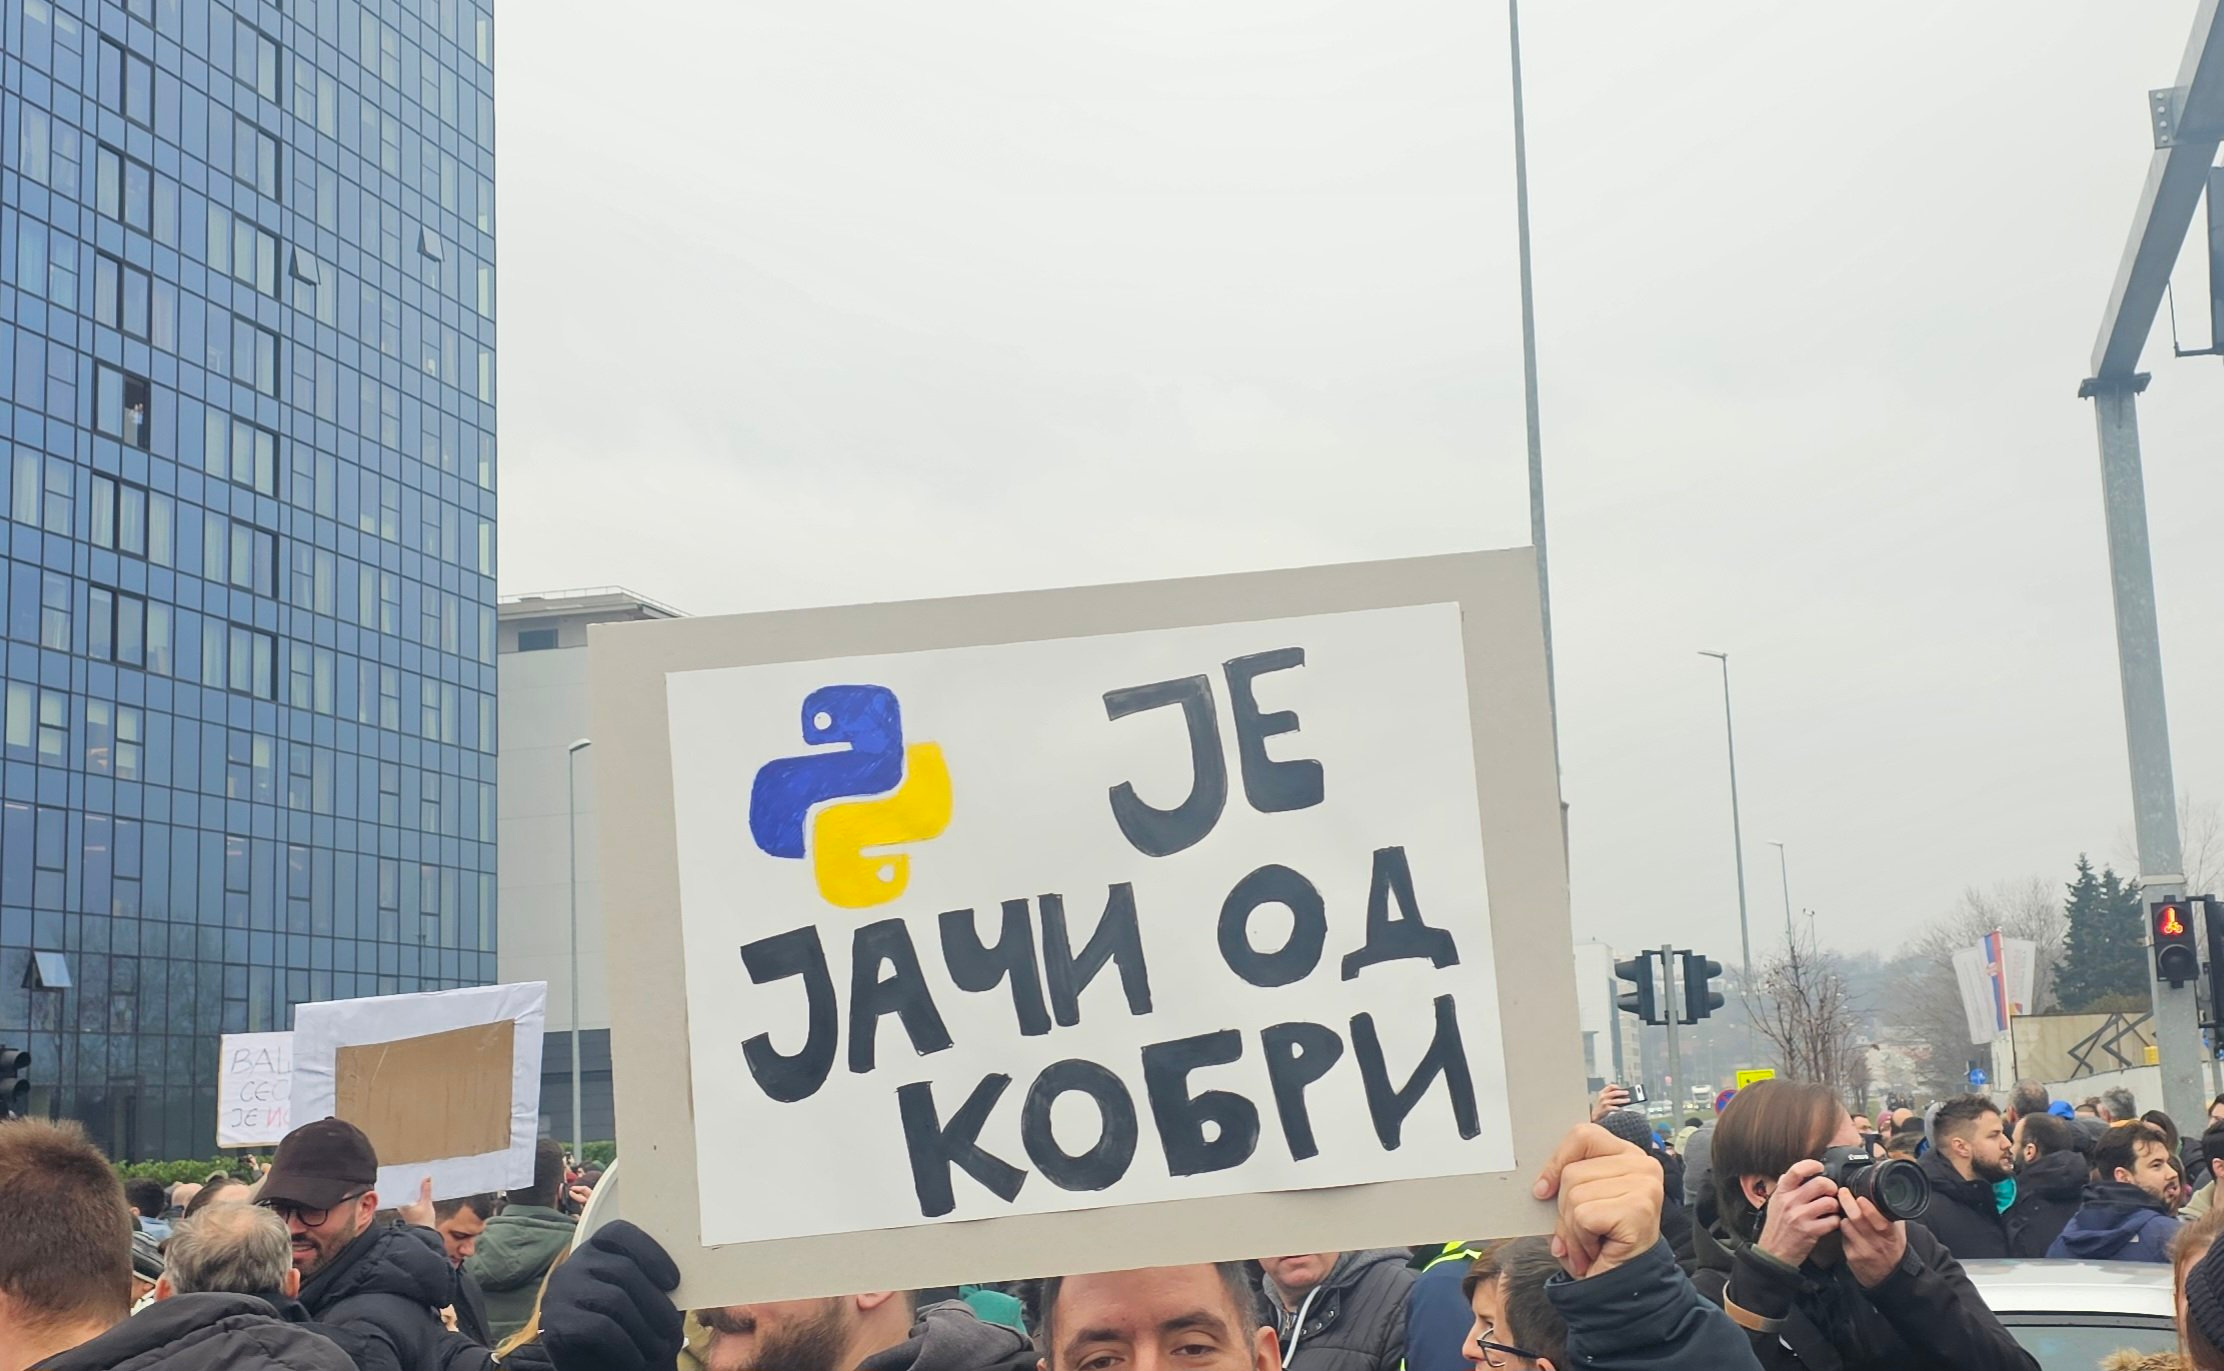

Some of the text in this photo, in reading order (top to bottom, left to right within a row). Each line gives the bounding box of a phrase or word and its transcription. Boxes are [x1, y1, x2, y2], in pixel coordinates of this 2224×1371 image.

[1102, 646, 1325, 858] ЈЕ
[740, 846, 1460, 1104] ЈАЧИ ОД
[896, 994, 1481, 1218] КОБРИ
